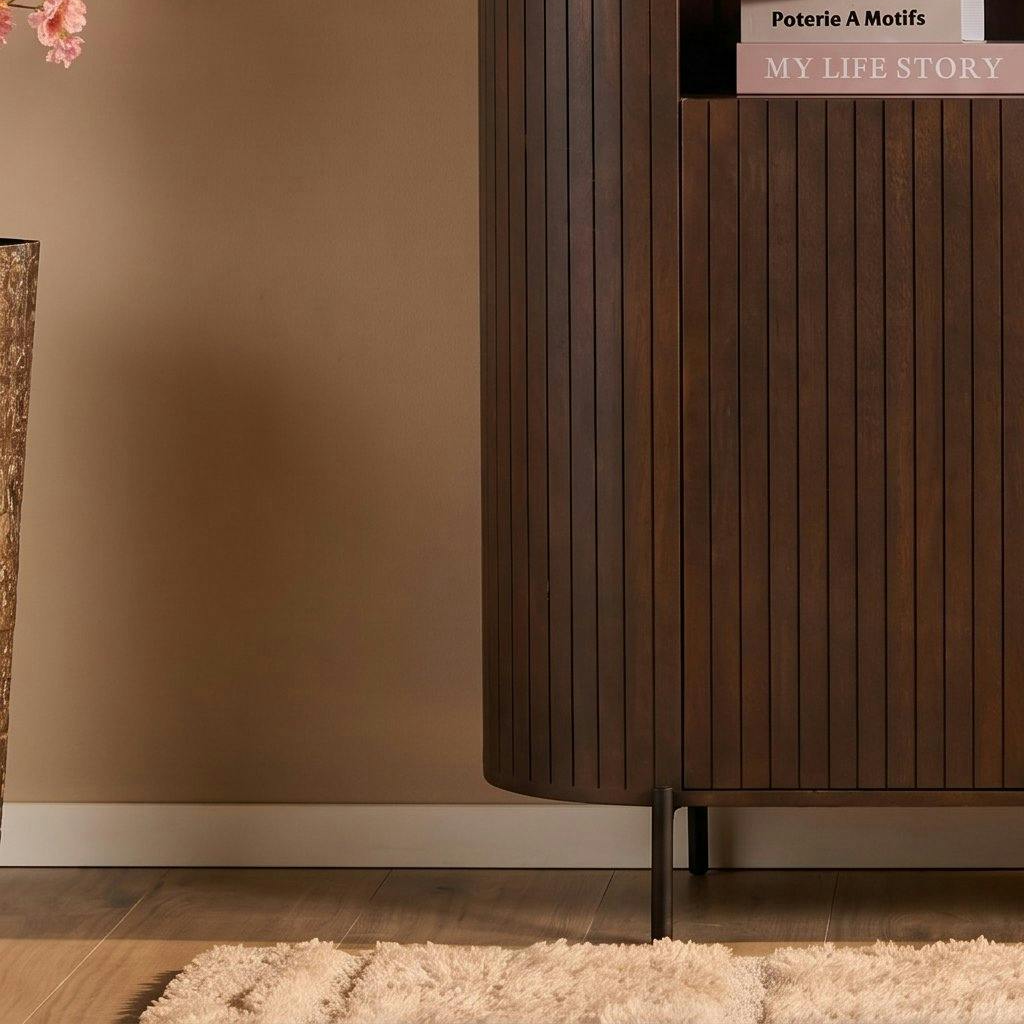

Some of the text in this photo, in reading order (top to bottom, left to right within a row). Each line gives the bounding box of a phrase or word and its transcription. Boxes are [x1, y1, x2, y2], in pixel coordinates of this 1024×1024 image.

[771, 9, 926, 28] Poterie A Motifs
[764, 57, 1003, 79] MY LIFE STORY
